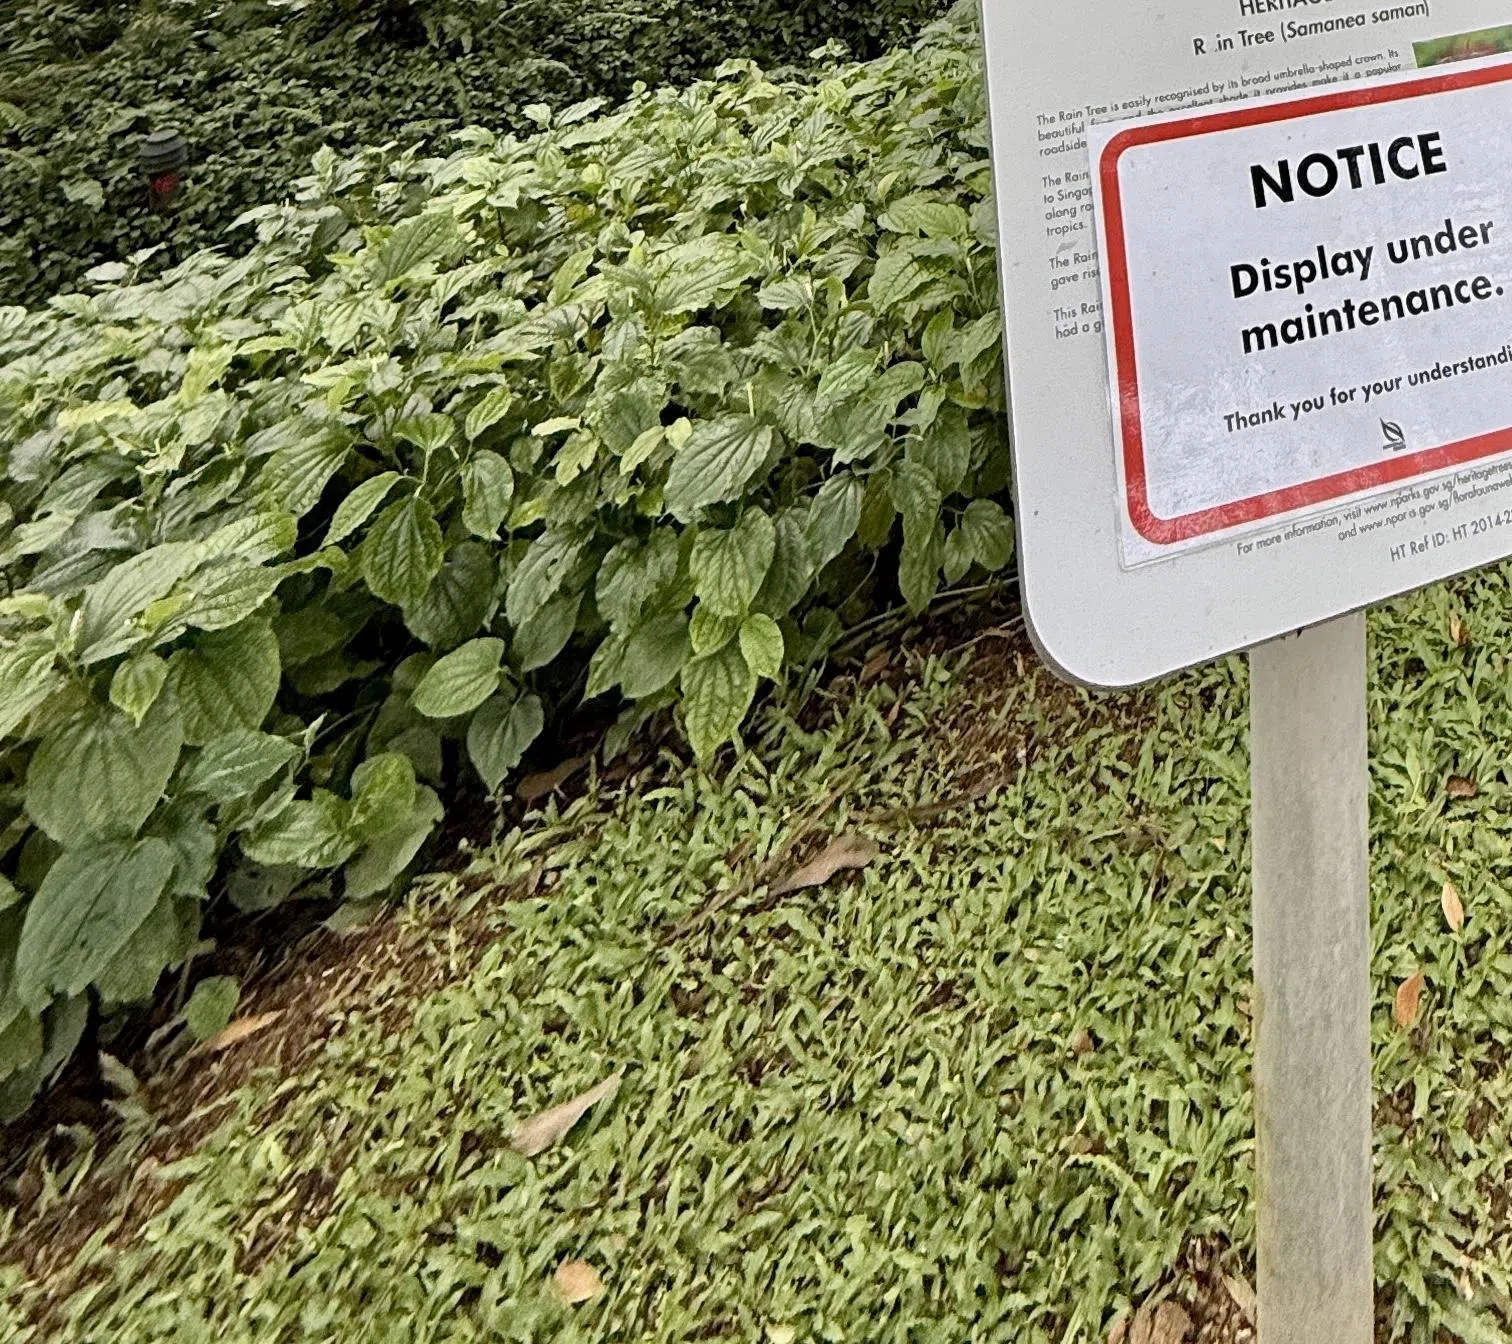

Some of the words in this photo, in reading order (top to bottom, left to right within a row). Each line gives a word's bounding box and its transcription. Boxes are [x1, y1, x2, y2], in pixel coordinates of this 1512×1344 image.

[1192, 33, 1234, 56] Rin
[1238, 29, 1275, 48] Tree
[1281, 13, 1366, 43] (Samanea
[1036, 114, 1056, 126] The
[1059, 110, 1082, 122] Rain
[1086, 105, 1108, 117] Tree
[1110, 102, 1119, 112] is
[1122, 95, 1151, 110] easily
[1154, 82, 1209, 103] recognised
[1212, 81, 1225, 94] by
[1228, 79, 1238, 90] its
[1241, 71, 1271, 87] broad
[1274, 55, 1352, 81] umbrella-shaped
[1388, 49, 1399, 59] Its
[1038, 122, 1085, 142] beautiful
[1039, 138, 1087, 157] roadside
[1042, 174, 1061, 188] The
[1064, 170, 1089, 183] Rain
[1250, 131, 1448, 209] NOTICE
[1045, 206, 1077, 220] along
[1046, 221, 1088, 238] tropics.
[1048, 256, 1069, 269] The
[1230, 244, 1374, 299] Display
[1386, 218, 1494, 264] under
[1050, 273, 1079, 290] gave
[1053, 306, 1077, 321] This
[1241, 274, 1504, 355] maintenance.
[1055, 321, 1078, 339] had
[1082, 323, 1090, 333] a
[1223, 401, 1287, 433] Thank
[1290, 395, 1325, 421] you
[1330, 385, 1356, 406] for
[1361, 374, 1403, 403] your
[1236, 542, 1253, 556] For
[1256, 534, 1282, 550] more
[1284, 515, 1342, 541] information,
[1343, 507, 1362, 521] visit
[1338, 522, 1357, 541] and
[1390, 543, 1407, 562] HT
[1410, 534, 1430, 556] Ref
[1431, 531, 1450, 549] ID:
[1452, 523, 1469, 542] HT
